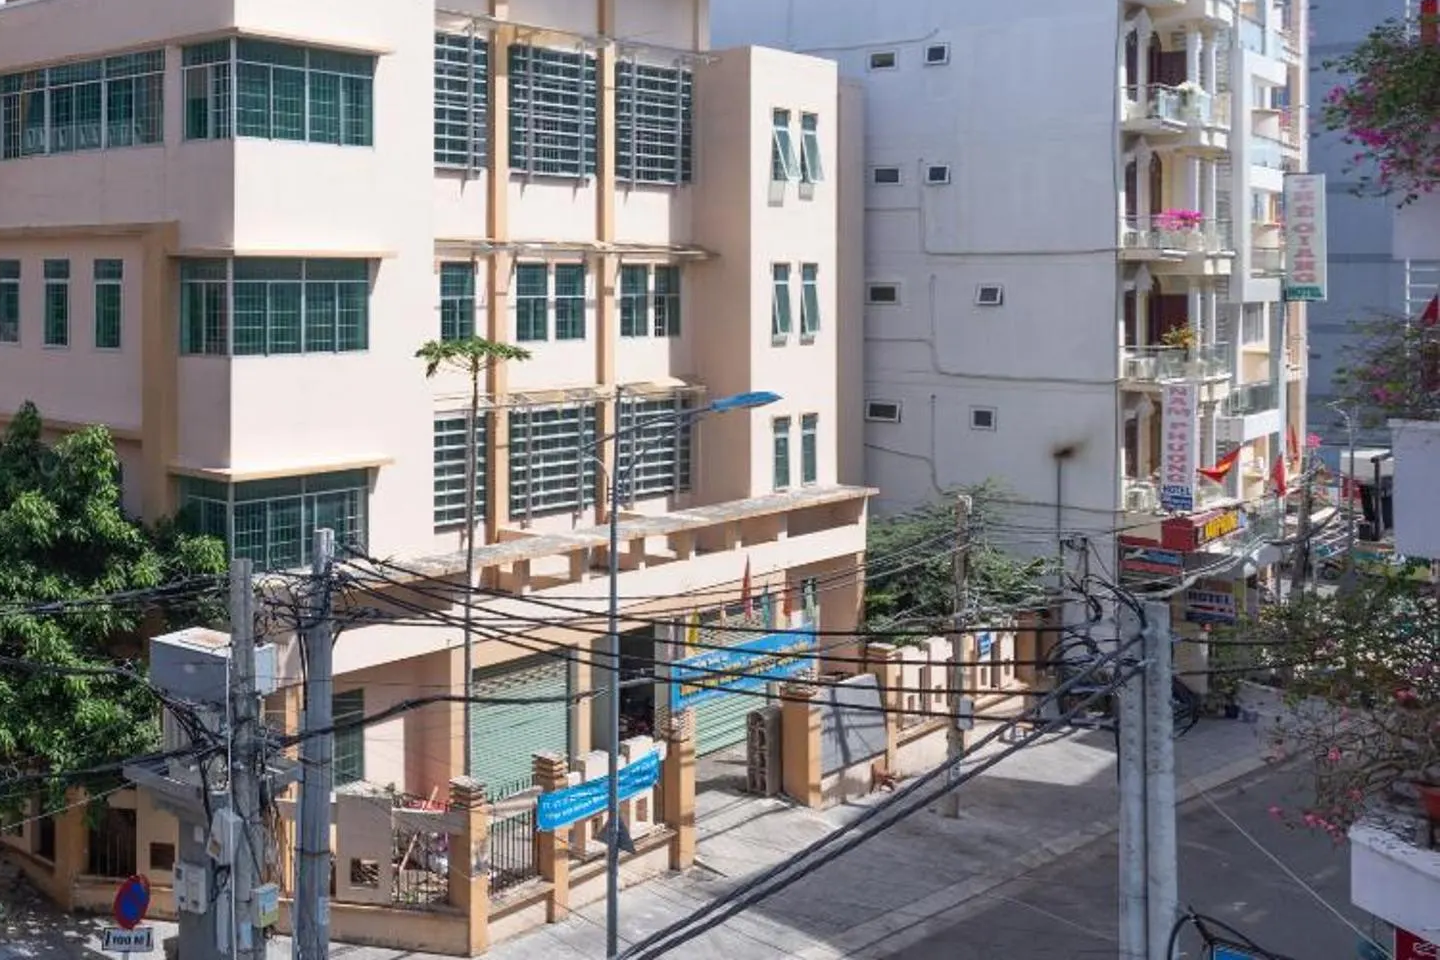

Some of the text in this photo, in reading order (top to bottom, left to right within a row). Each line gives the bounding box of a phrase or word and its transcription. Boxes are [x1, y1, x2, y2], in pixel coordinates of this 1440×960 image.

[1288, 285, 1323, 297] HOTEL
[1163, 485, 1192, 495] HOTEL
[1188, 590, 1229, 604] HOTEL
